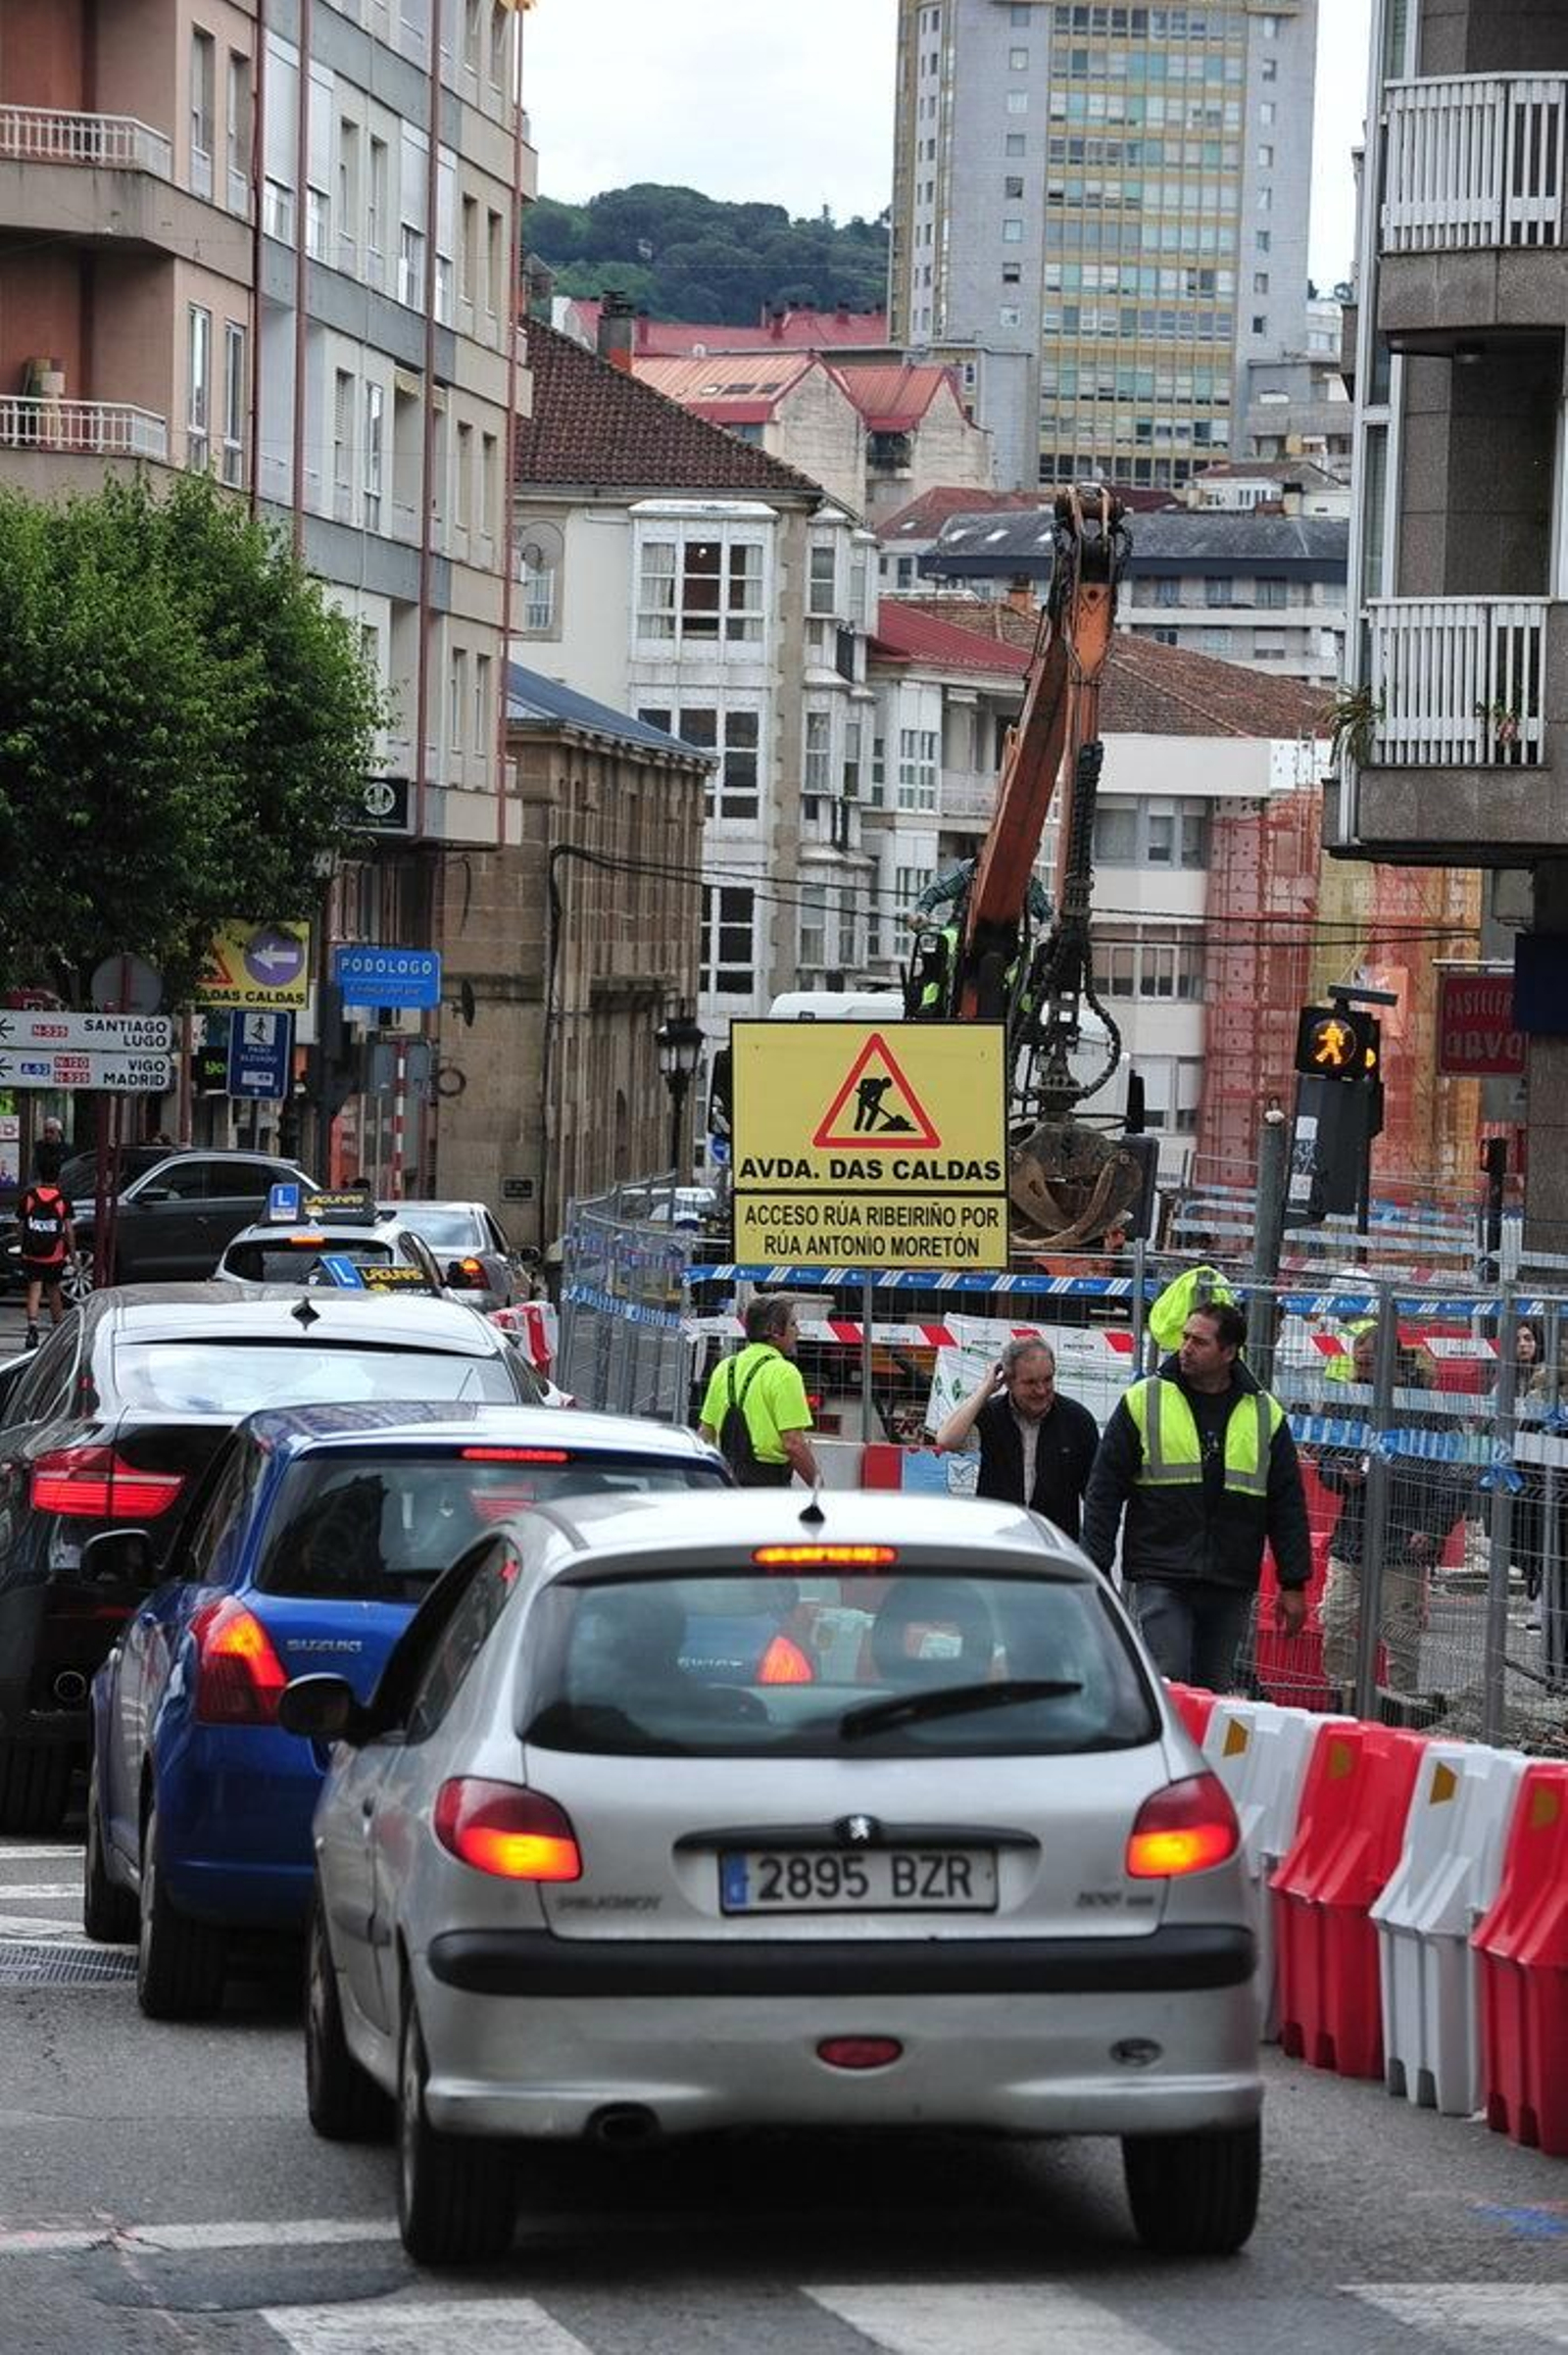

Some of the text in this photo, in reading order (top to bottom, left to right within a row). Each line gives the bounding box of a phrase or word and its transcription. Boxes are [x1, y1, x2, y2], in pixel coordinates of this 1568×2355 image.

[341, 958, 432, 975] PODOLOGO
[245, 991, 305, 1005] CALDAS
[1447, 991, 1514, 1017] PASTELER
[84, 1019, 167, 1033] SANTIAGO
[123, 1035, 167, 1047] LUGO
[128, 1059, 166, 1072] VIGO
[104, 1073, 166, 1086] MADRID
[739, 1159, 1002, 1181] AVDA. DAS CALDAS
[277, 1190, 290, 1206] L
[745, 1201, 1000, 1228] ACCESO RÚA RIBEIRIÑO POR
[764, 1229, 980, 1257] RÚA ANTONIO MORETÓN
[331, 1260, 355, 1283] L
[287, 1639, 363, 1653] SUZUKI
[758, 1855, 972, 1899] 2895 BZR
